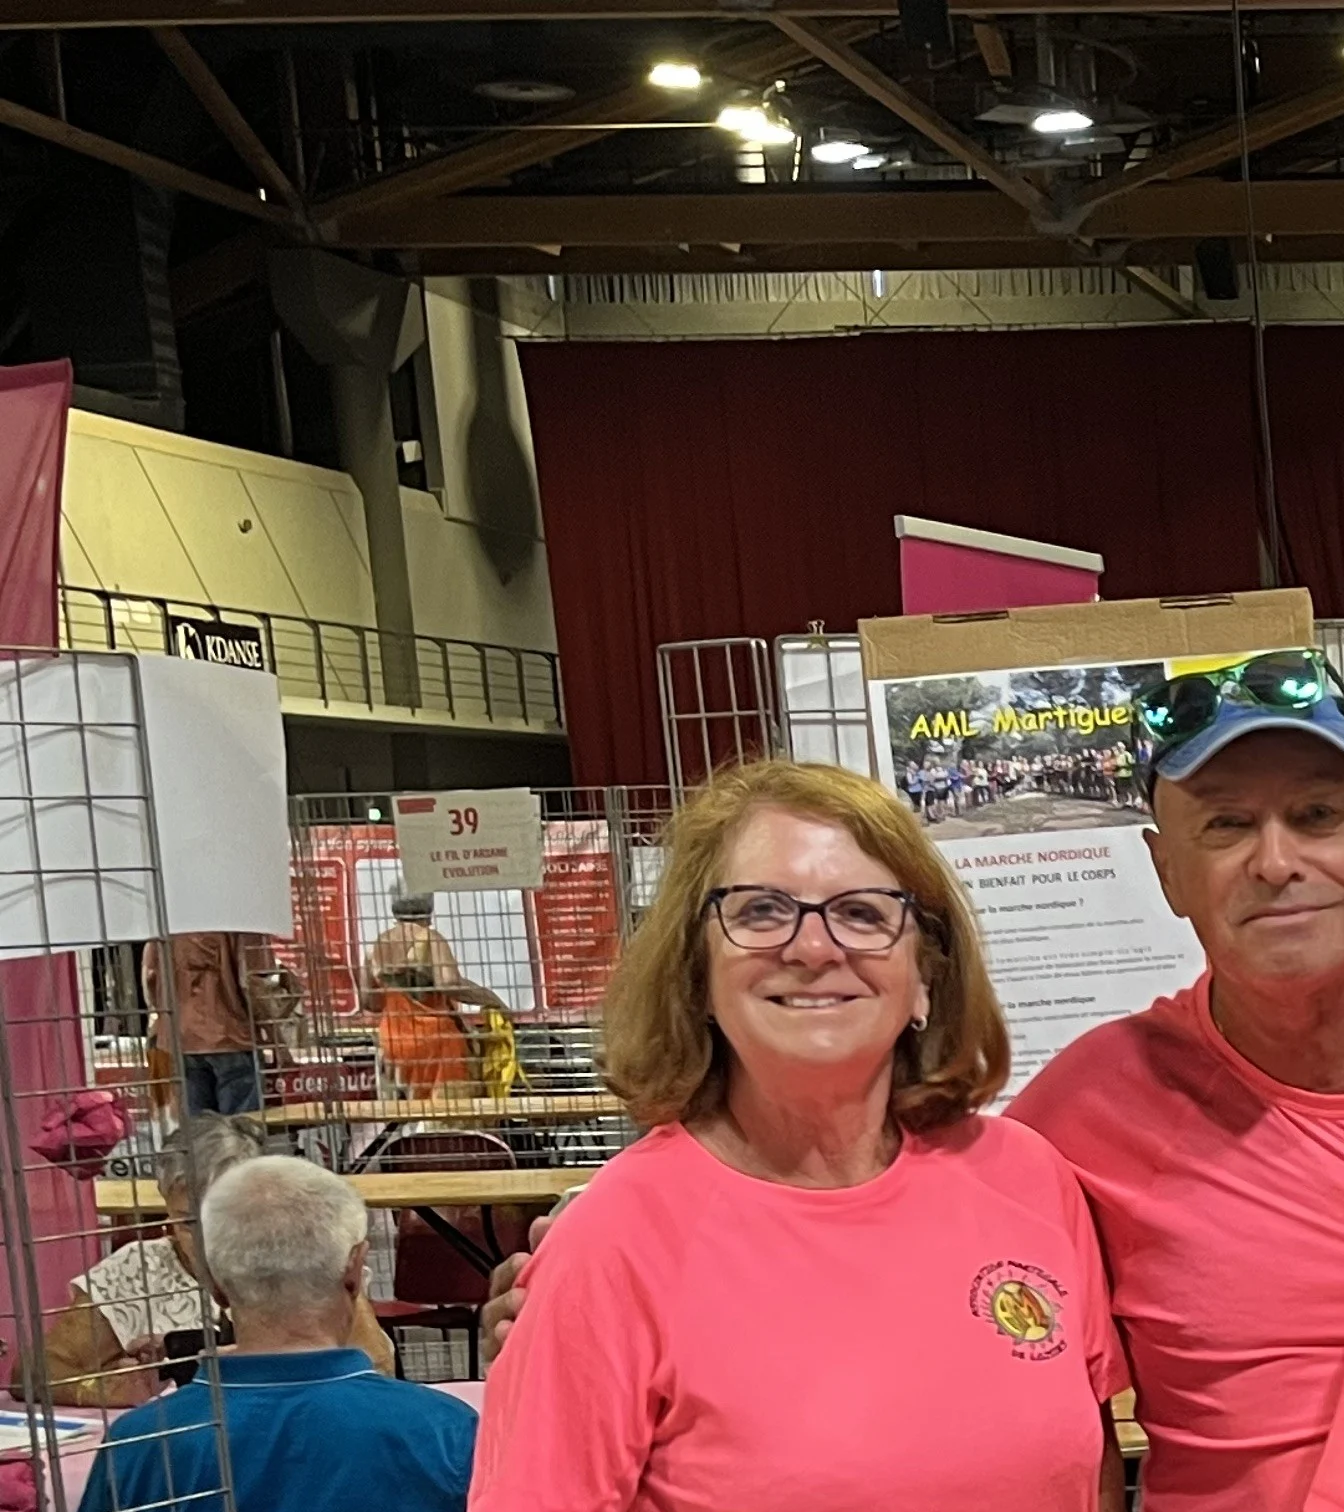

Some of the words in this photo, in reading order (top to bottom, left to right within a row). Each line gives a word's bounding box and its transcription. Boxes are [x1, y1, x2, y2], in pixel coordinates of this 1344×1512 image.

[205, 635, 262, 668] KDANSE
[910, 711, 979, 740] AML
[992, 704, 1132, 735] Martigue
[447, 807, 479, 836] 39
[955, 858, 972, 870] LA
[975, 852, 1034, 868] MARCHE
[1038, 846, 1112, 864] NORDIQUE
[979, 874, 1026, 889] BIENFAIT
[1032, 872, 1062, 885] POUR
[1067, 870, 1079, 882] LE
[1081, 868, 1117, 881] CORPS
